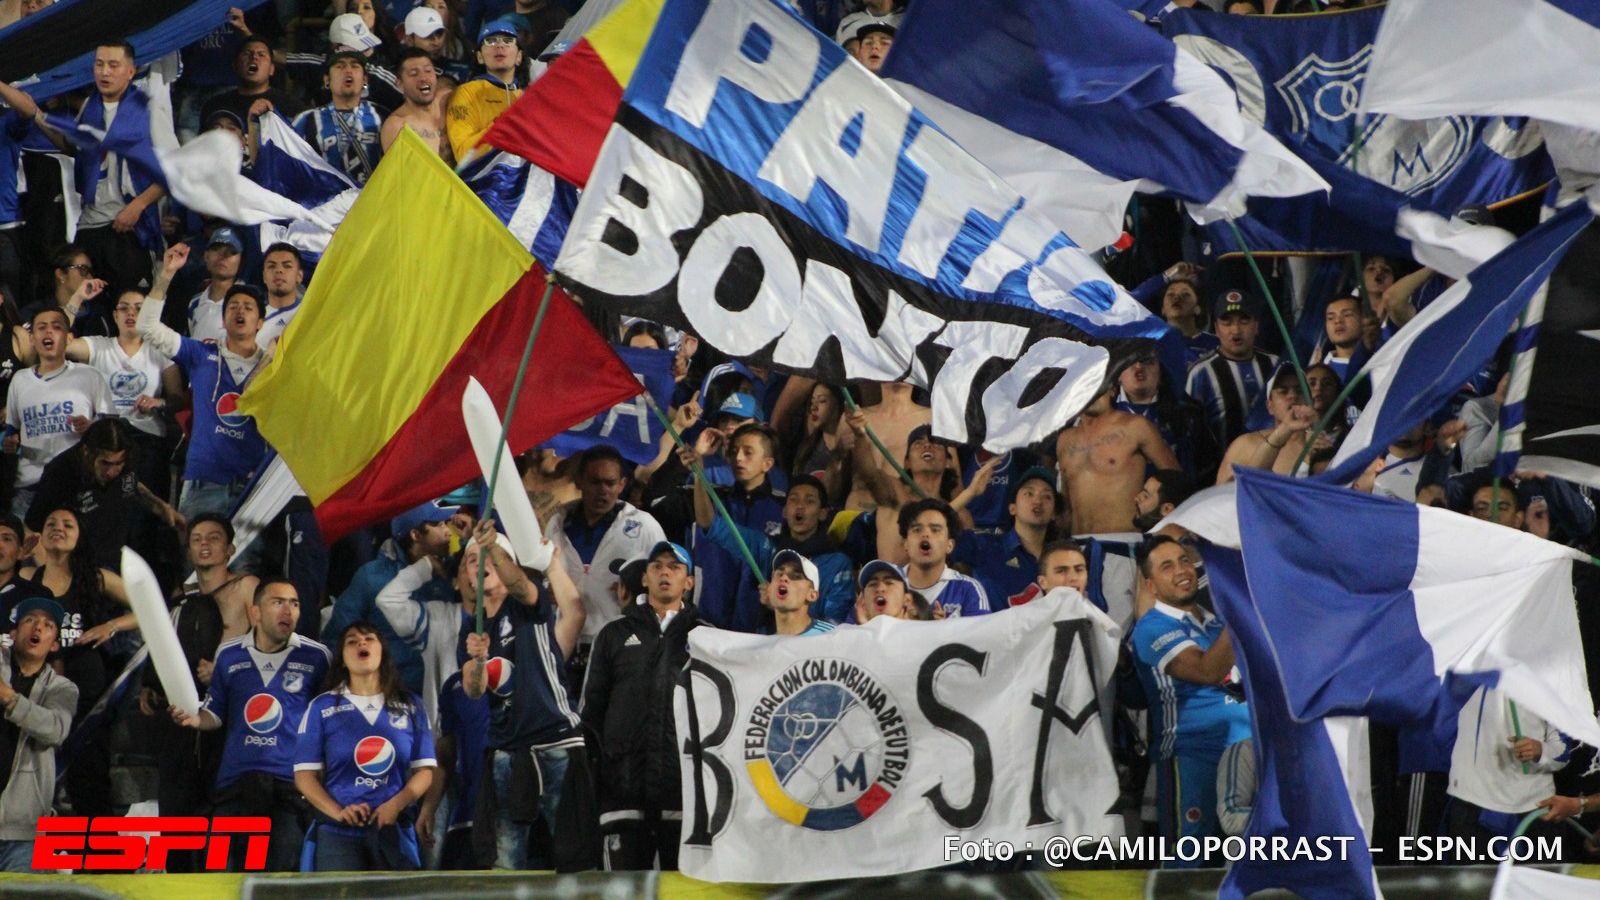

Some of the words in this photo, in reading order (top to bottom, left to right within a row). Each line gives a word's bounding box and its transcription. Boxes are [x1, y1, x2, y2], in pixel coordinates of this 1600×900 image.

[665, 0, 1152, 326] PATIO
[744, 665, 803, 760] FEDERACION
[802, 659, 887, 715] COLOMBIANA
[244, 735, 278, 747] pepsi
[876, 705, 903, 732] DE
[833, 752, 868, 792] M
[877, 725, 909, 788] FUTBOL
